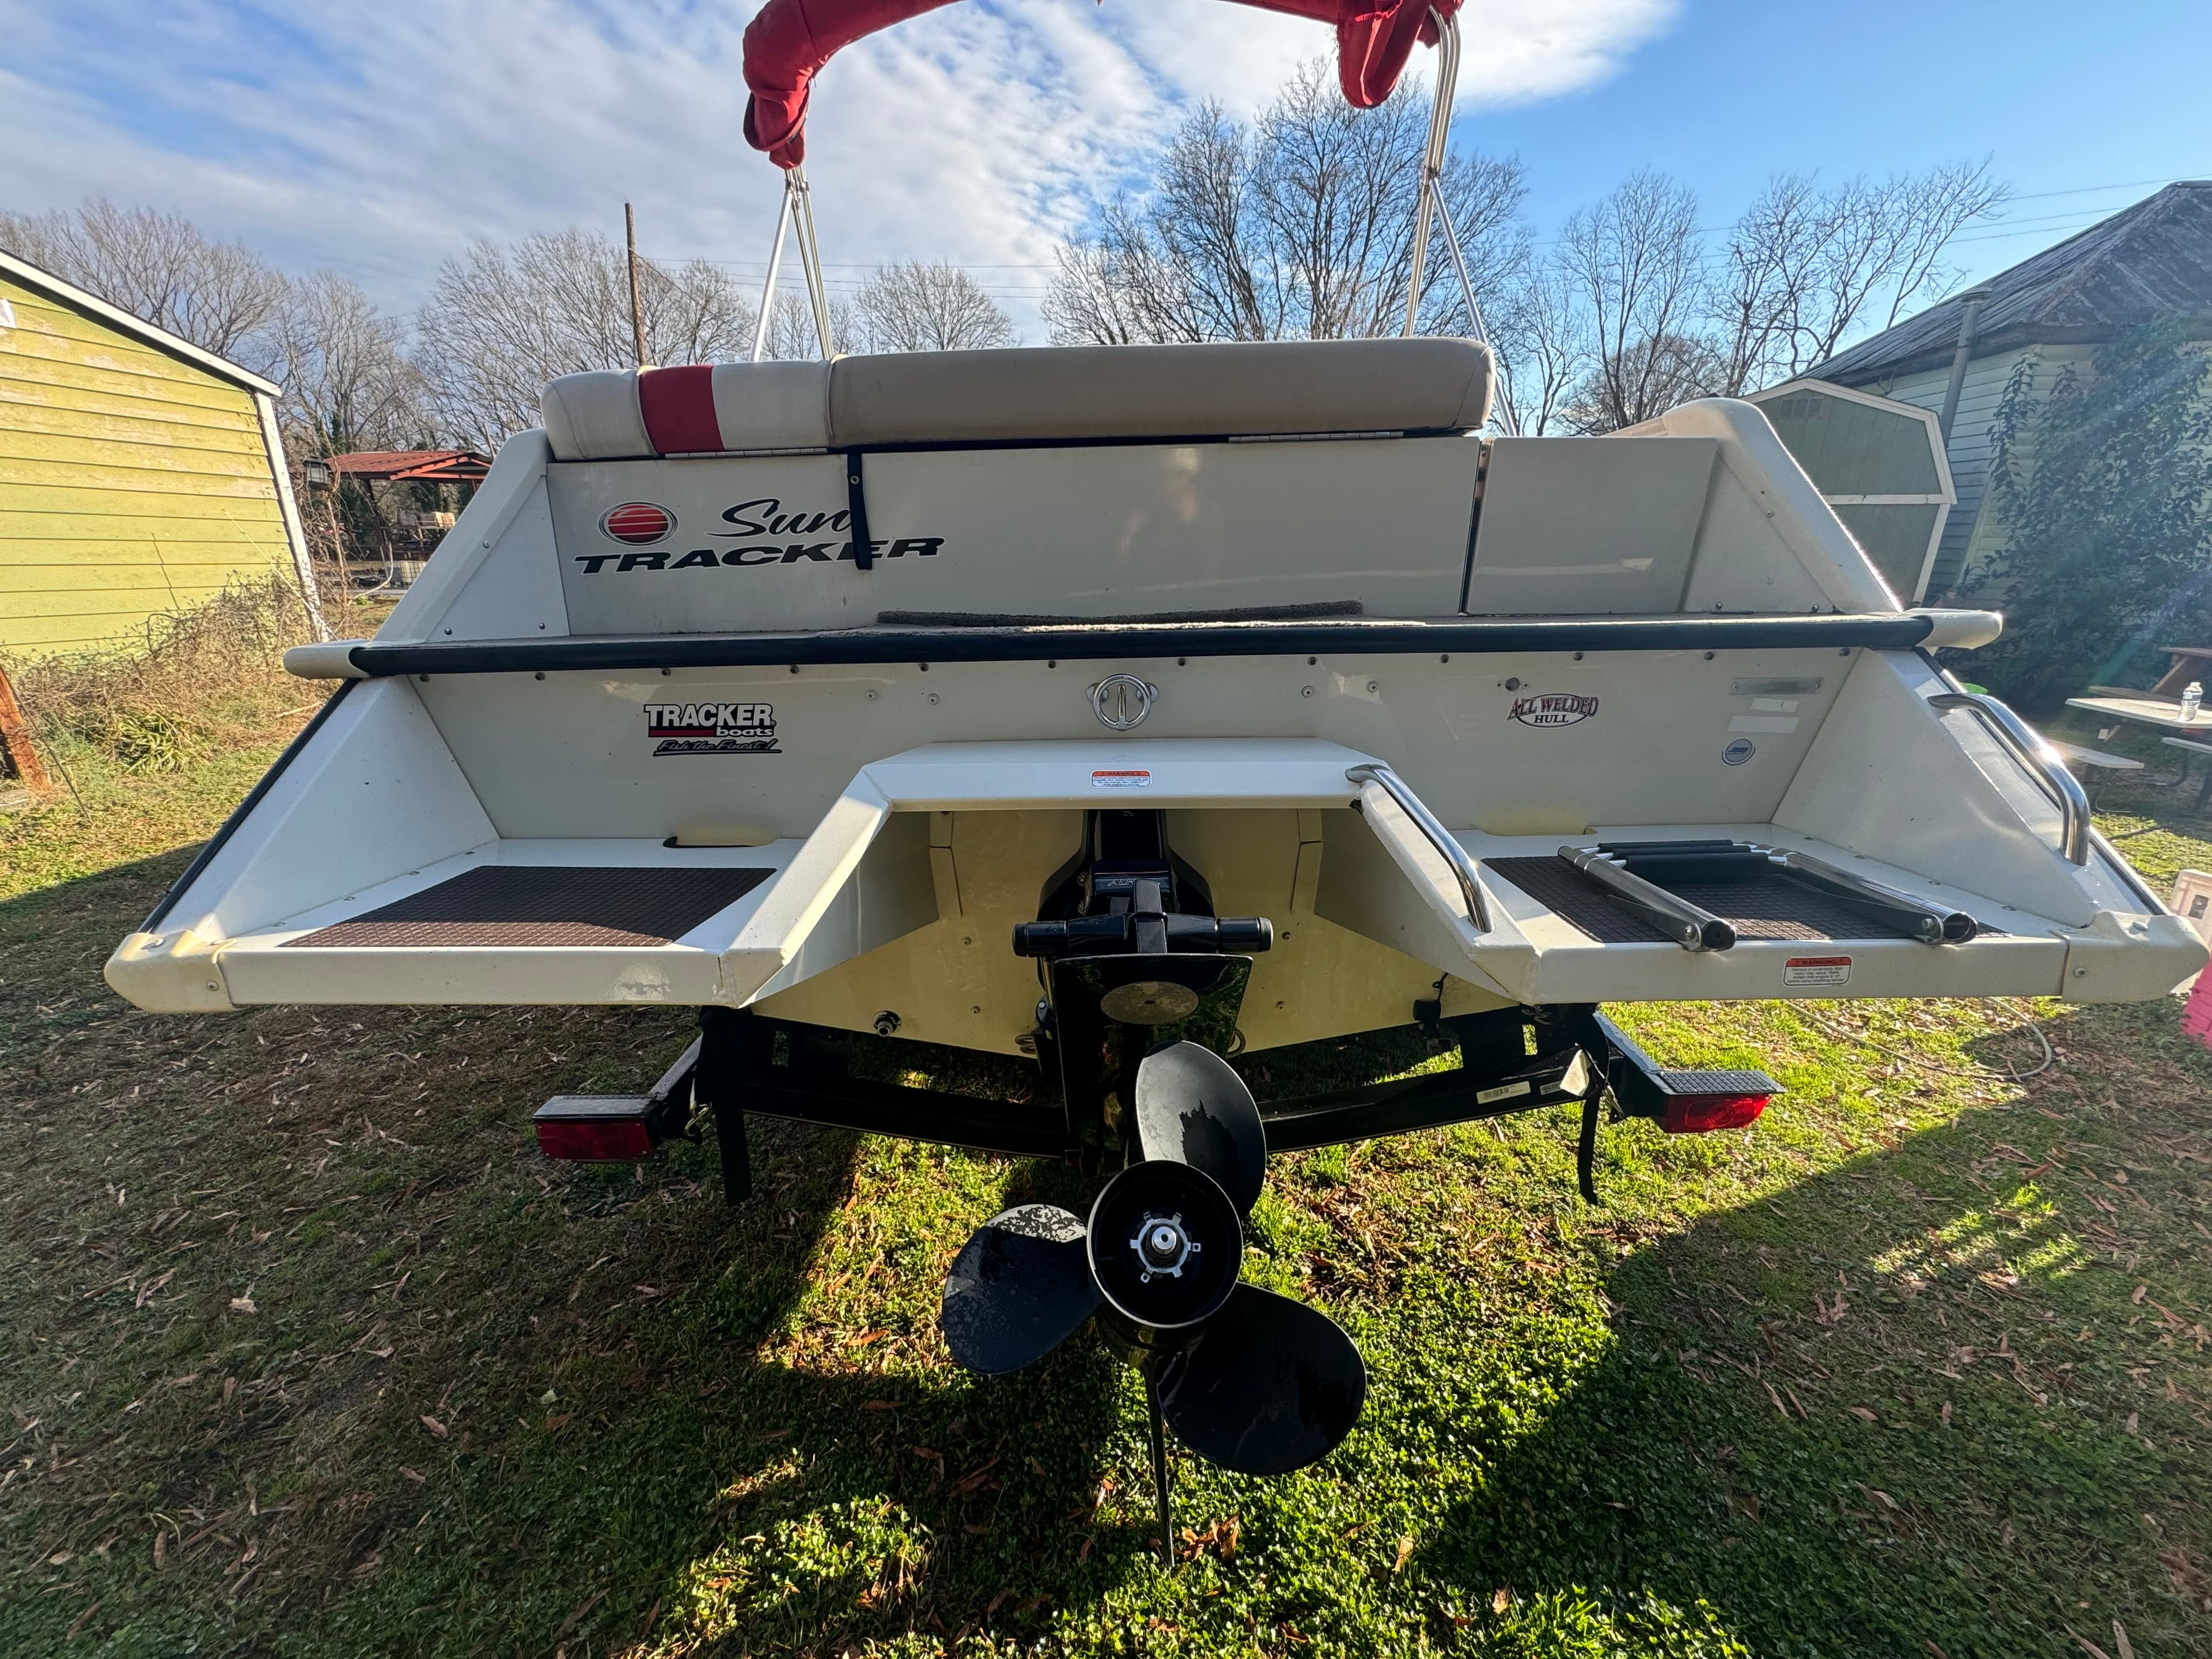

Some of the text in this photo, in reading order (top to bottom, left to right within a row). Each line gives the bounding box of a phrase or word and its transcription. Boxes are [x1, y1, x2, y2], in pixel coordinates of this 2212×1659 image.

[705, 499, 851, 537] Sun
[575, 537, 945, 574] TRACKER
[644, 703, 773, 728] TRACKER
[1506, 697, 1599, 721] ALL WELDED
[1533, 714, 1569, 724] HULL
[716, 726, 773, 736] boats
[658, 740, 690, 750] Fish
[691, 741, 715, 749] the
